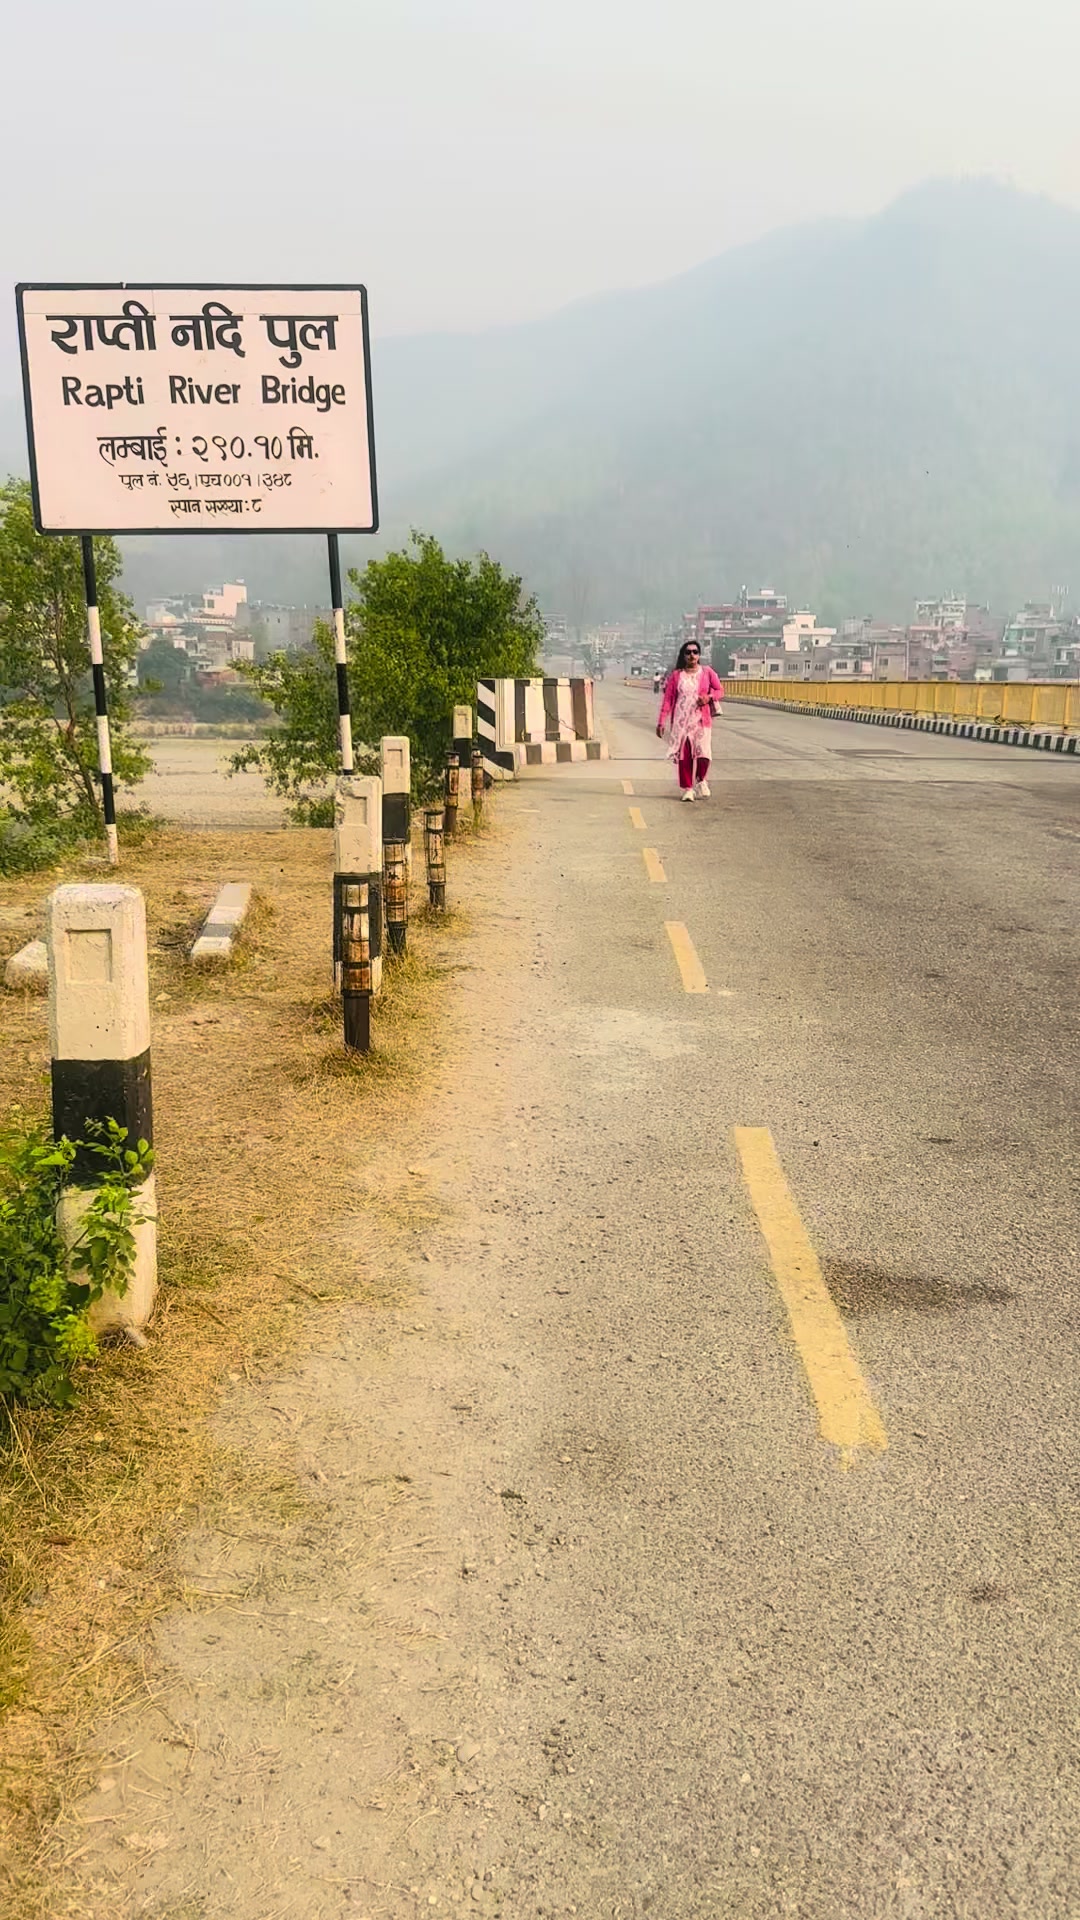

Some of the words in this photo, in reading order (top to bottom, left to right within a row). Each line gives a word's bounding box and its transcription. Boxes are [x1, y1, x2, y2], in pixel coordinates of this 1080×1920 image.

[45, 299, 157, 355] राप्ती
[169, 301, 246, 358] नदि
[260, 315, 339, 369] पुल
[62, 375, 146, 410] Rapti
[168, 376, 241, 406] River
[261, 374, 346, 413] Bridge
[191, 435, 283, 463] २९०.१०
[118, 473, 144, 491] पुल
